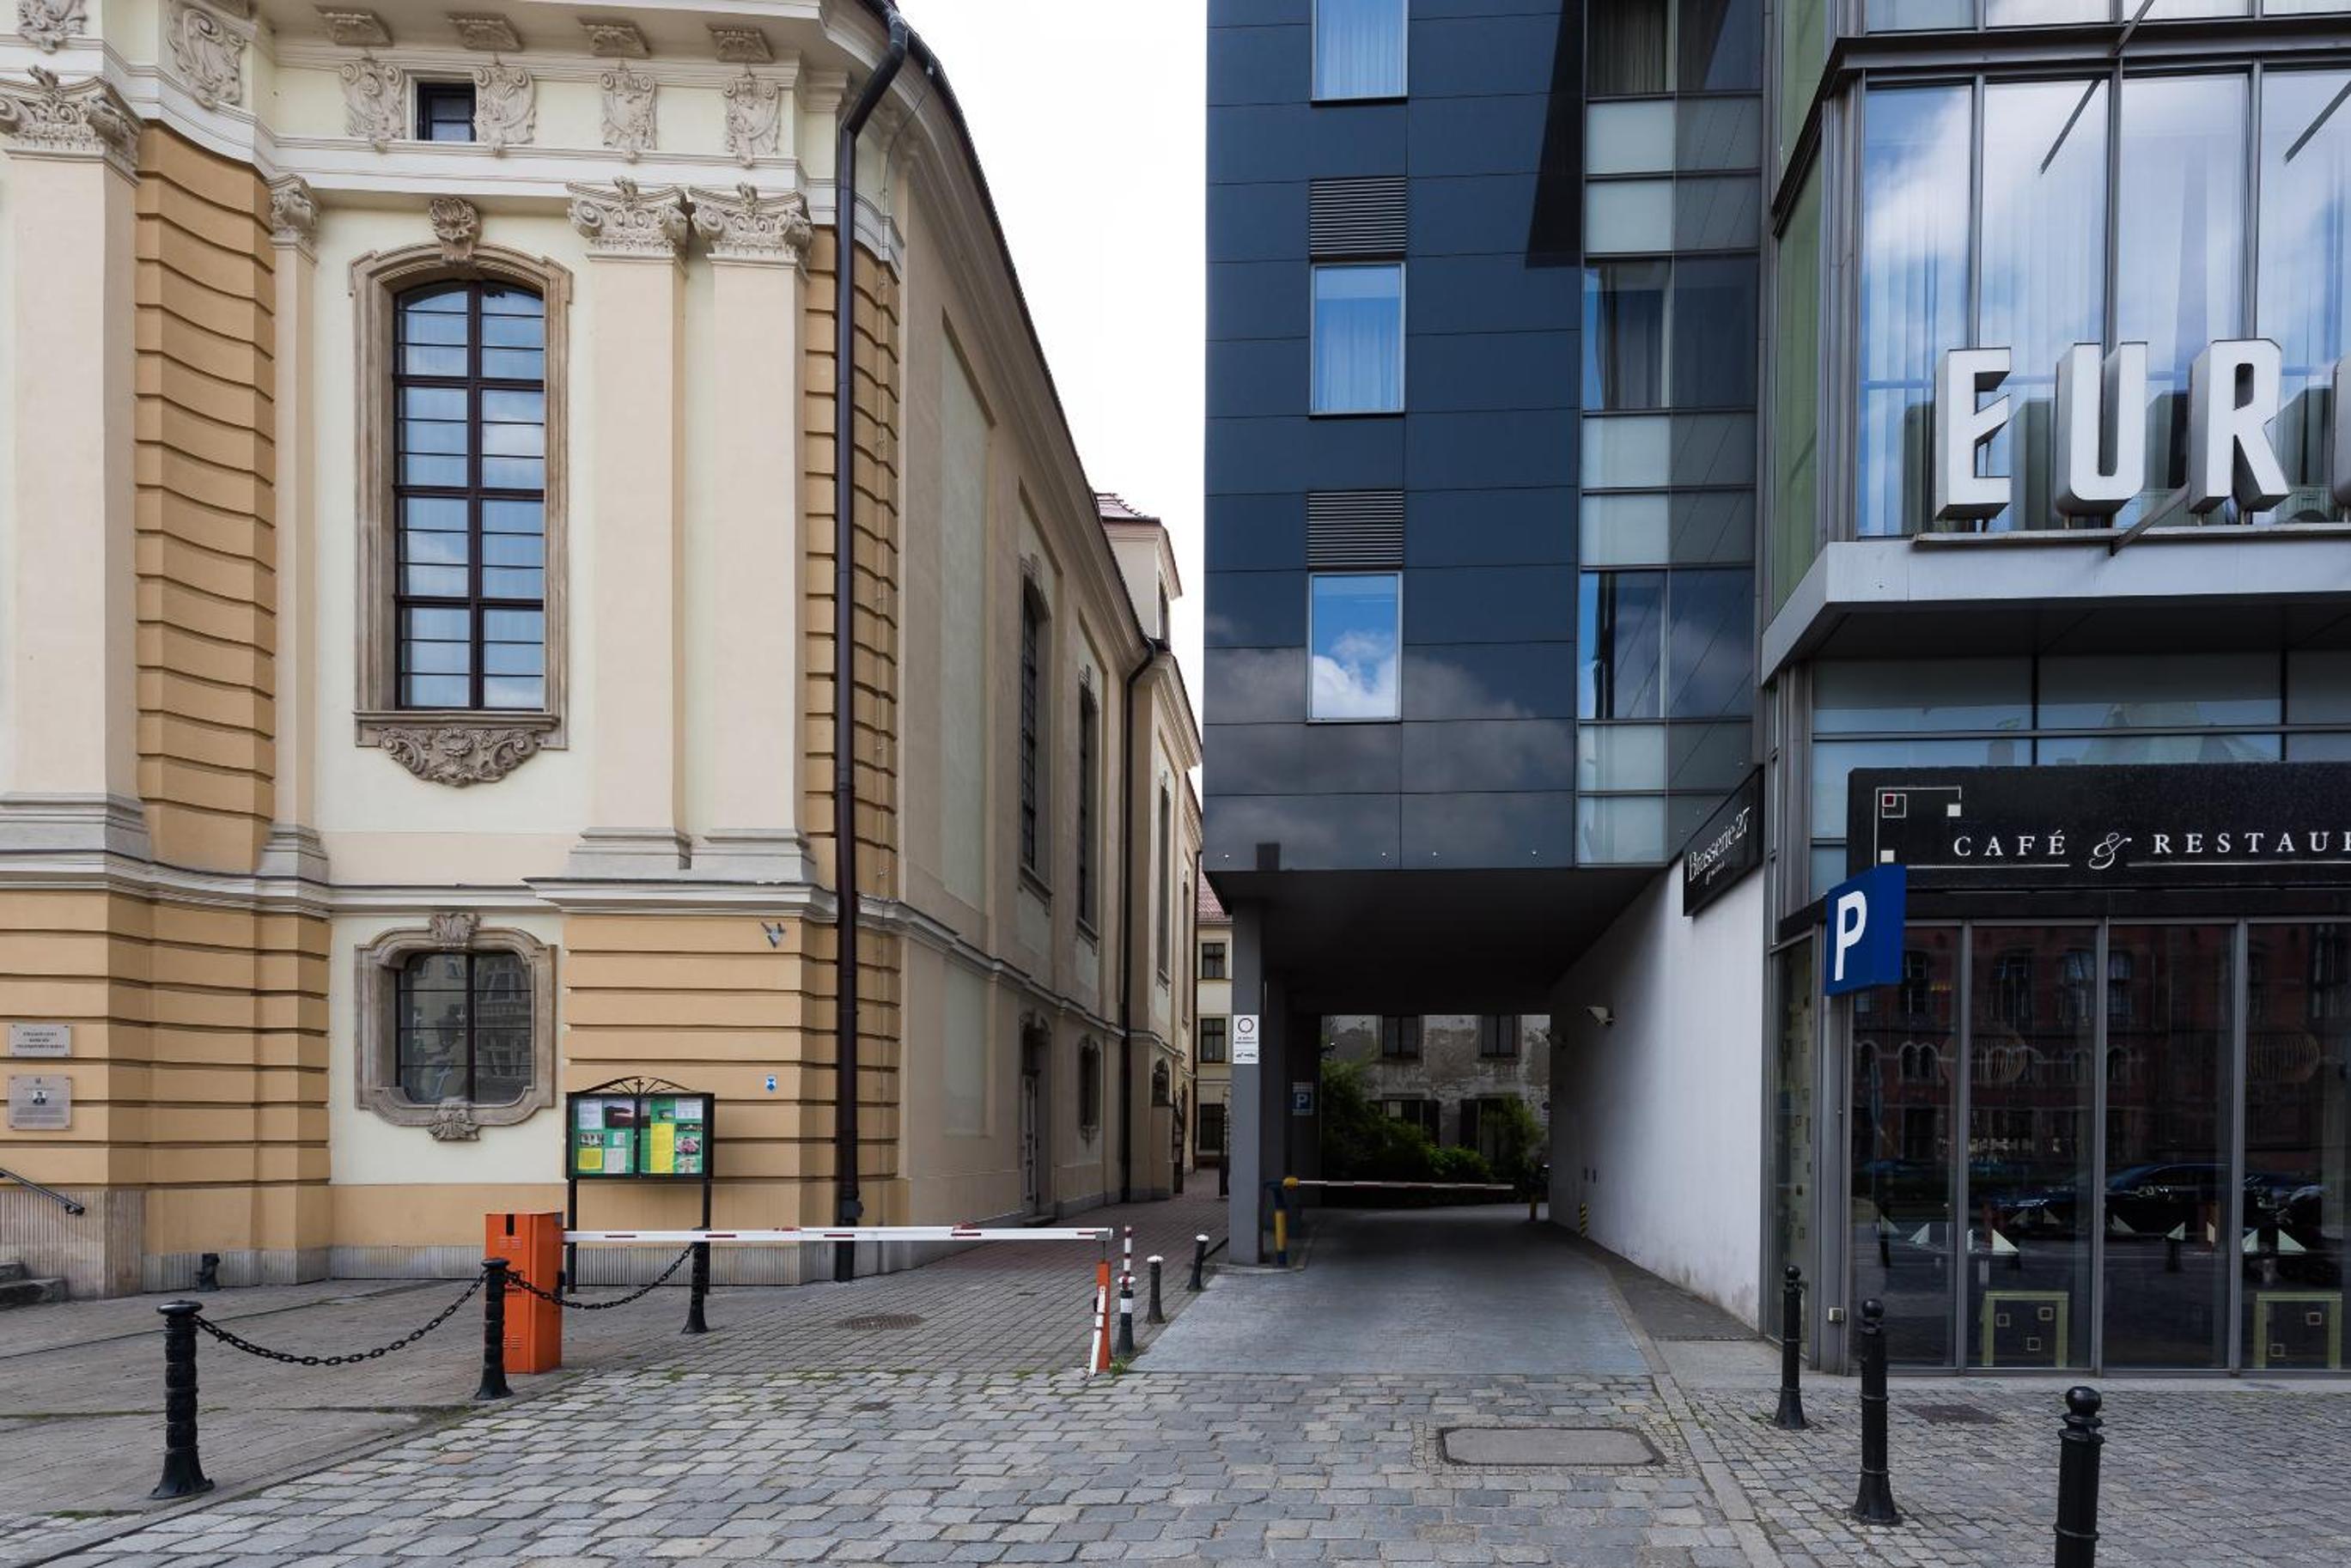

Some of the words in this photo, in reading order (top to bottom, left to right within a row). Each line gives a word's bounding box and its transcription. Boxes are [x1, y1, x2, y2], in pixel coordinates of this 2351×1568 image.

[1935, 338, 2351, 520] EUR
[1689, 826, 1735, 882] Brasserie
[1953, 830, 2066, 857] CAFÉ
[2088, 832, 2132, 870] &
[1835, 890, 1867, 982] P
[1295, 1092, 1309, 1109] P
